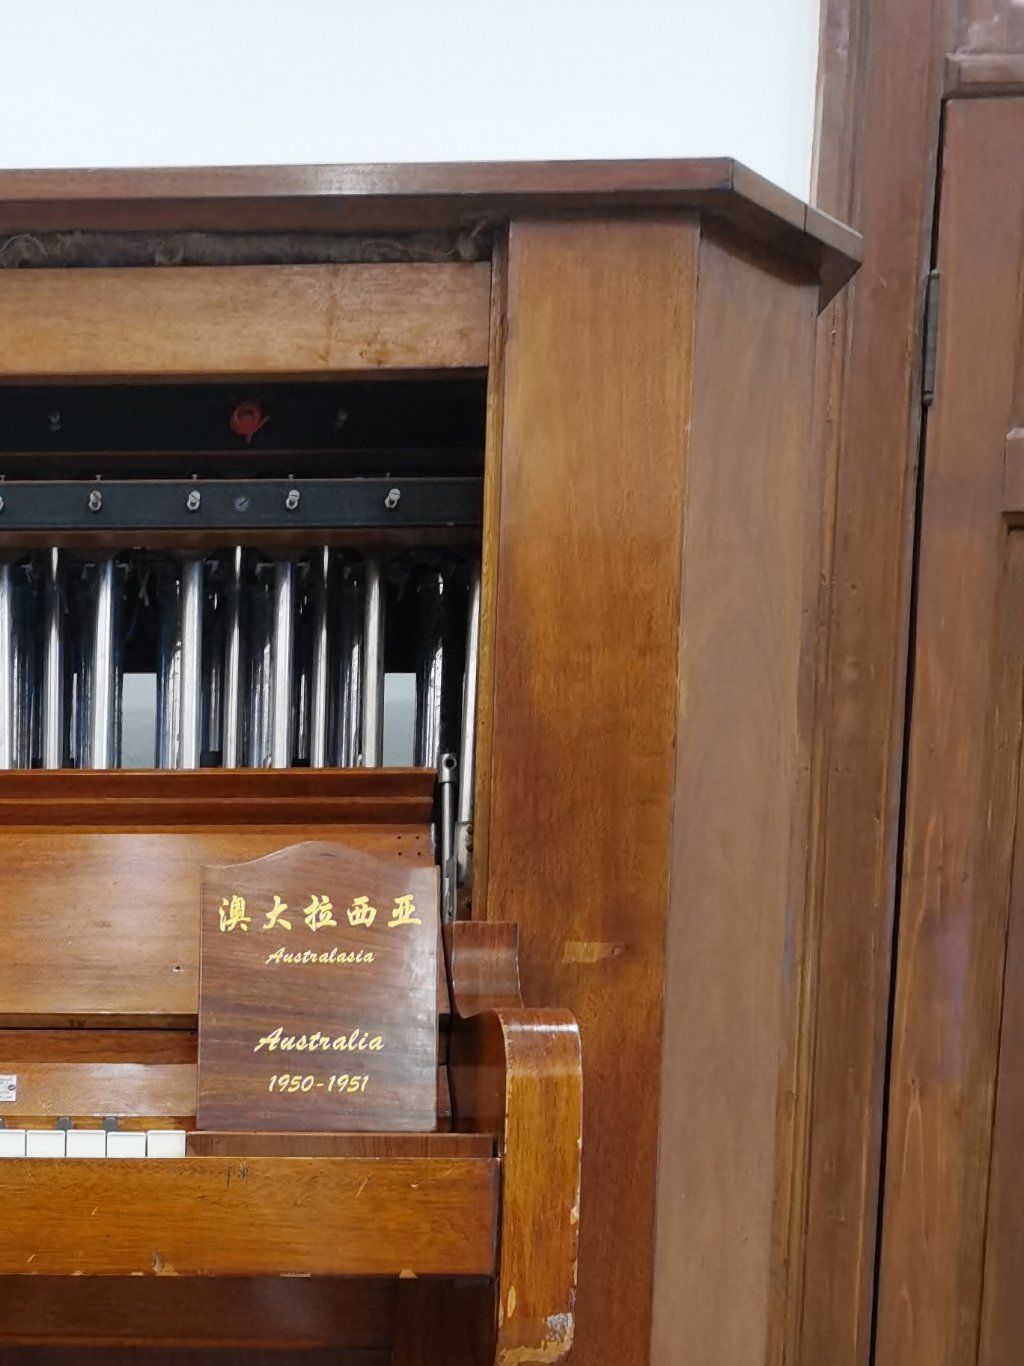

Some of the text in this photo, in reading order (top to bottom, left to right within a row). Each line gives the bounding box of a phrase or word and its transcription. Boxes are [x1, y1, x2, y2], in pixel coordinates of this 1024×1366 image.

[219, 894, 422, 931] 澳大拉西亚
[265, 947, 375, 965] Australasia
[254, 1027, 384, 1052] Australia
[268, 1074, 369, 1092] 1950-1951
